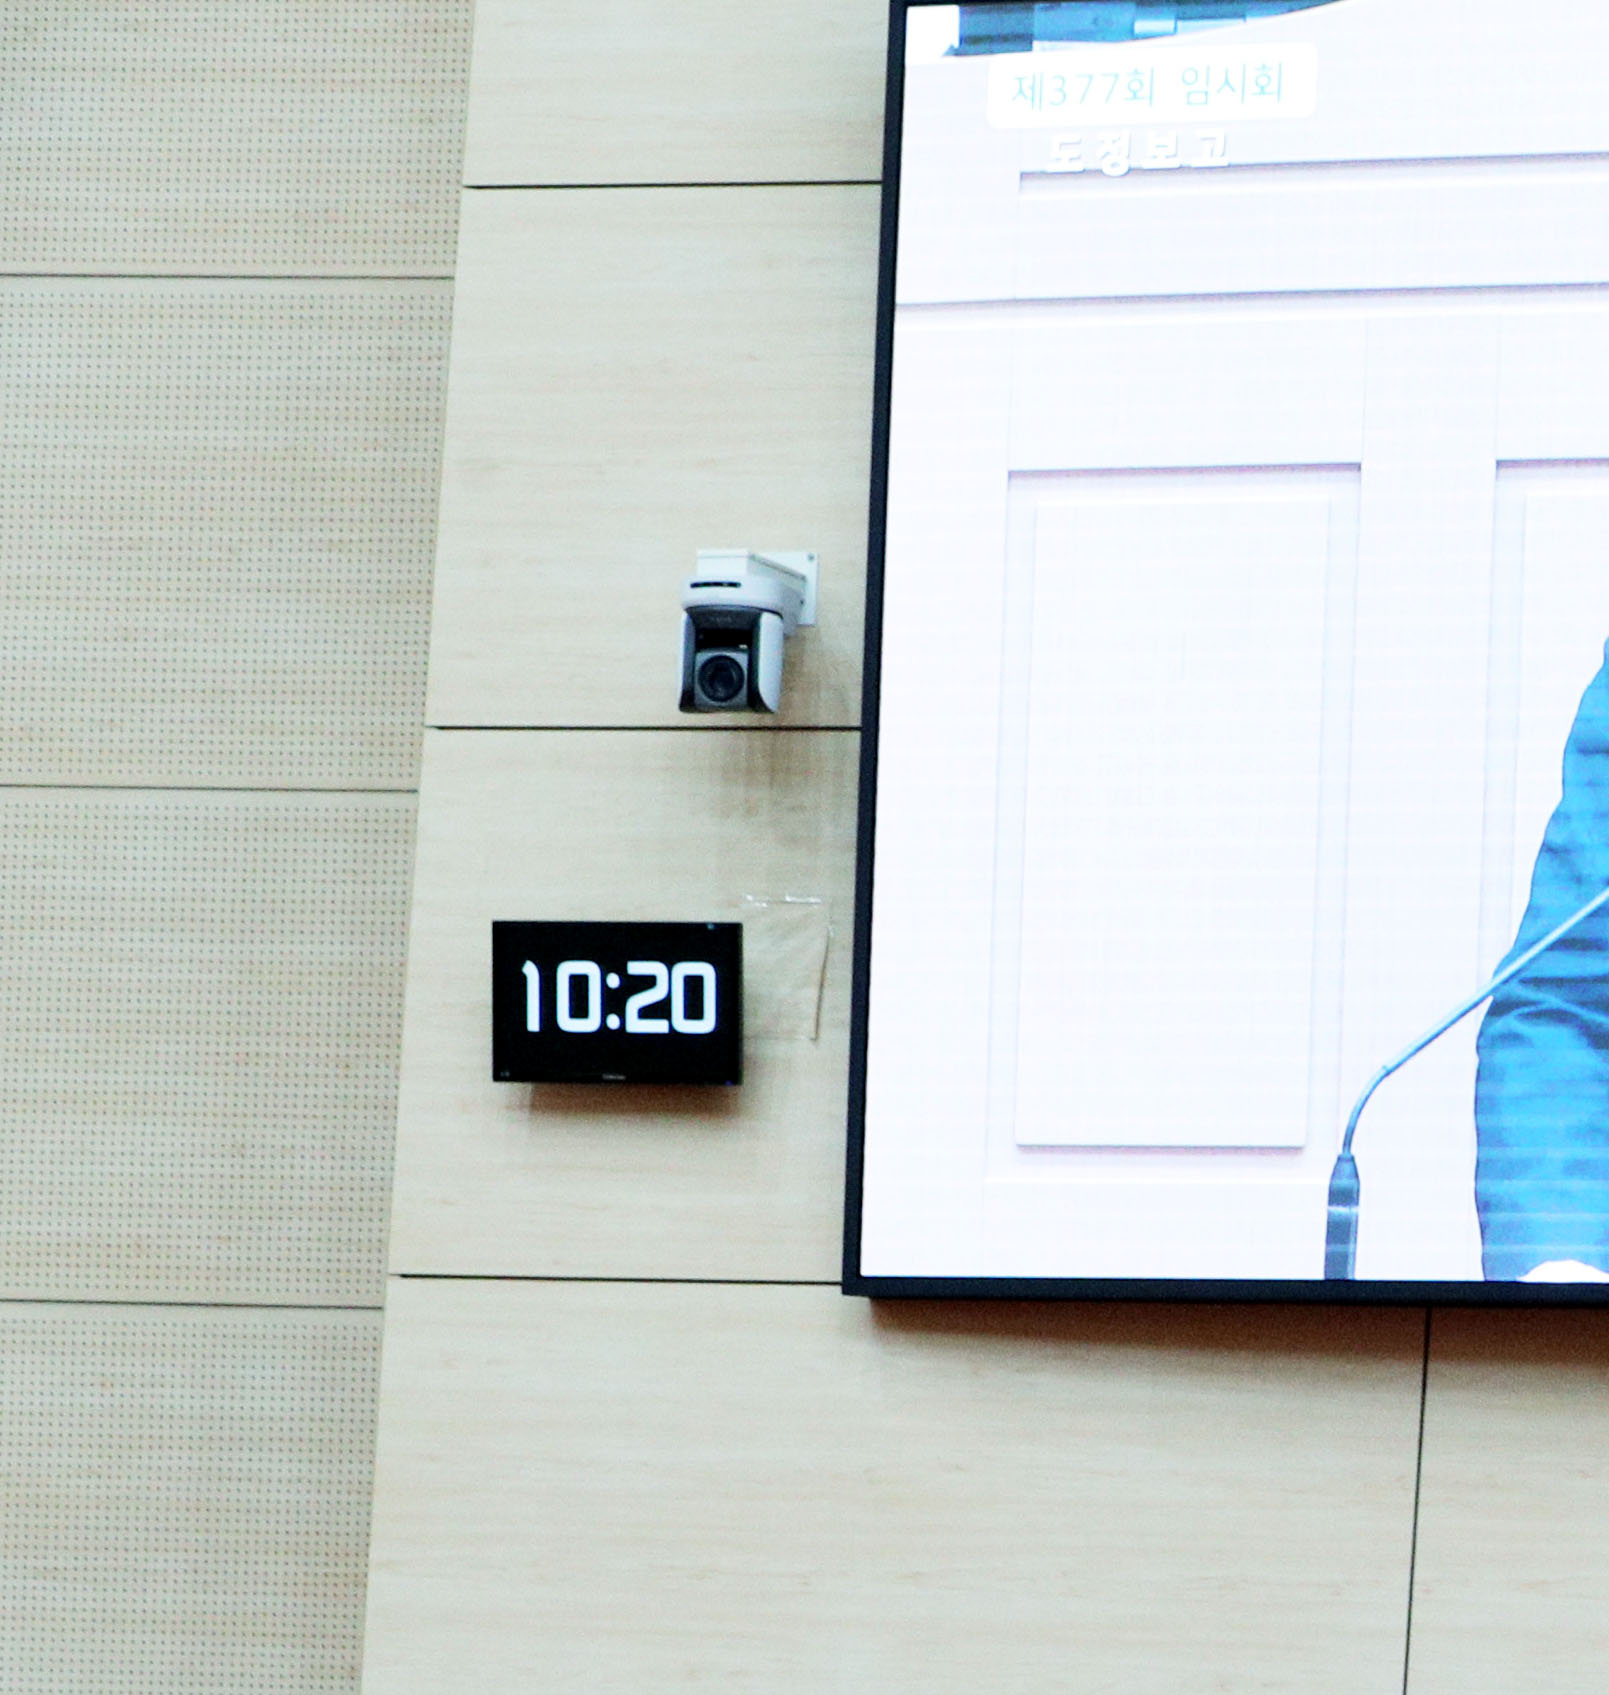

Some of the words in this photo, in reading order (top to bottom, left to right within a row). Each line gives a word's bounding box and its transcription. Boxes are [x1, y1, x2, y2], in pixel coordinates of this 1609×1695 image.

[1011, 66, 1155, 112] 제377회
[1181, 61, 1284, 105] 임시회
[1046, 129, 1232, 177] 도정보고
[521, 959, 717, 1034] 10:20
